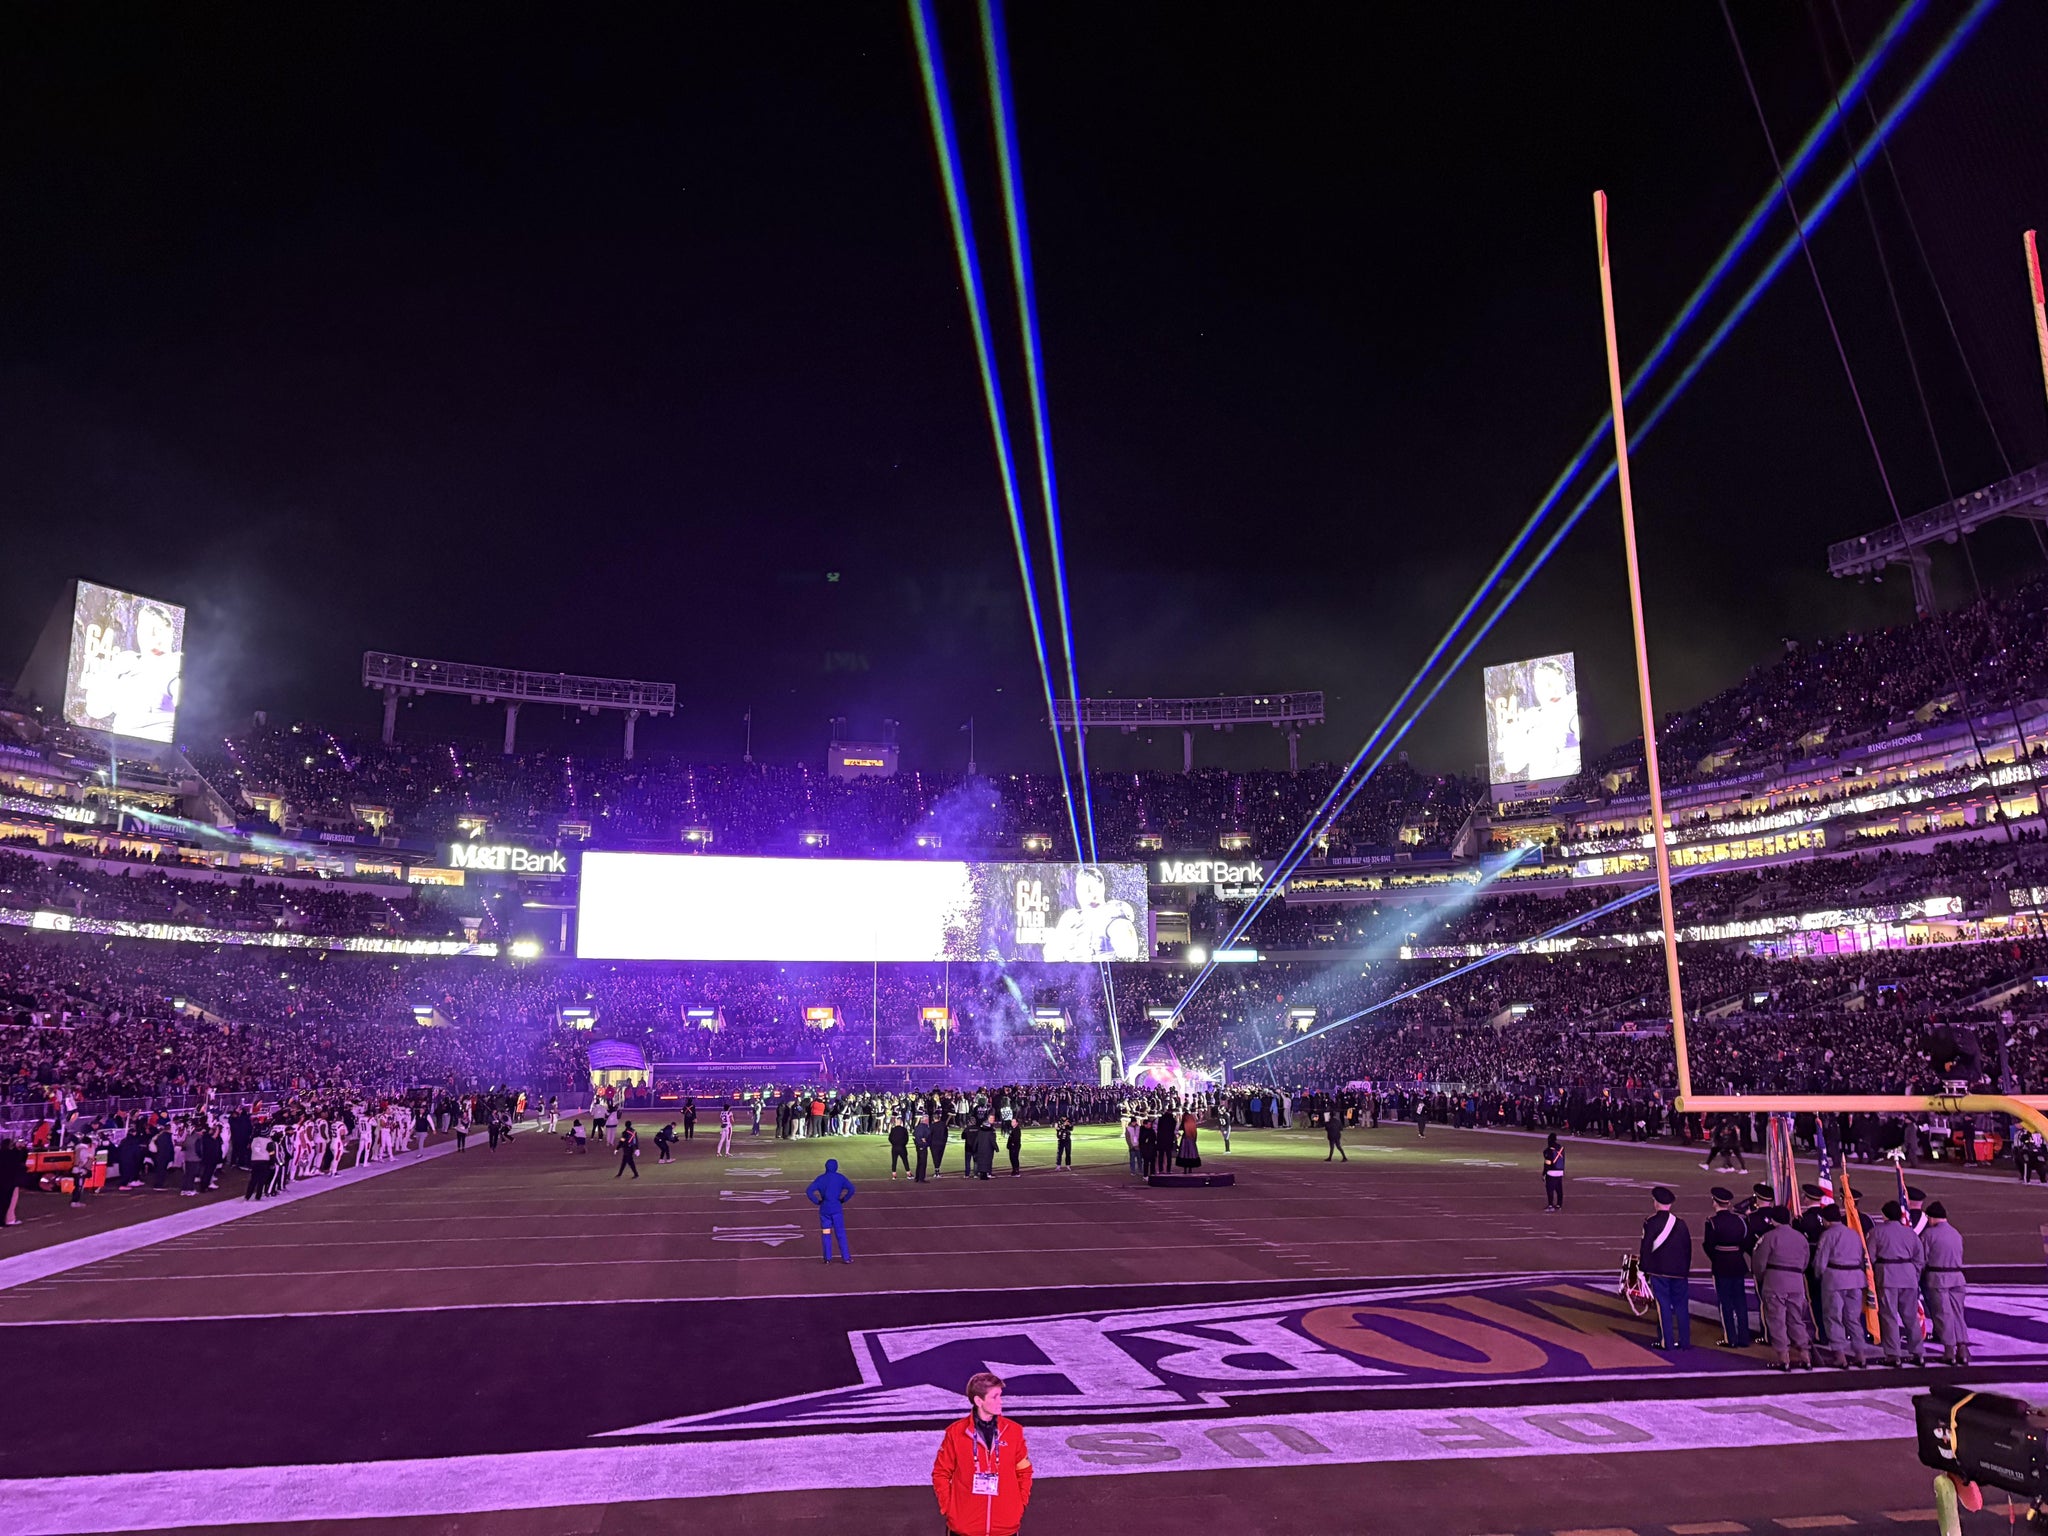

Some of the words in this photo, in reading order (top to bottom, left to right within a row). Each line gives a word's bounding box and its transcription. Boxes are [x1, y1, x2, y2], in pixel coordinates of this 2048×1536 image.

[5, 745, 41, 758] 2006-2014
[1867, 741, 1887, 753] RING
[1891, 733, 1923, 747] HONOR
[1697, 781, 1720, 791] TERRELL
[1720, 777, 1738, 786] SUGGS
[1514, 790, 1539, 798] MedStar
[1610, 796, 1636, 805] MARSHAL
[151, 821, 187, 834] merritt
[320, 832, 356, 844] #RAVENSFLOCK
[450, 843, 511, 870] M&T
[511, 848, 567, 873] Bank
[1160, 861, 1213, 883] M&T
[1214, 861, 1264, 882] Bank
[1016, 880, 1042, 911] 64
[1420, 1411, 1654, 1450] OF
[1066, 1422, 1333, 1465] US
